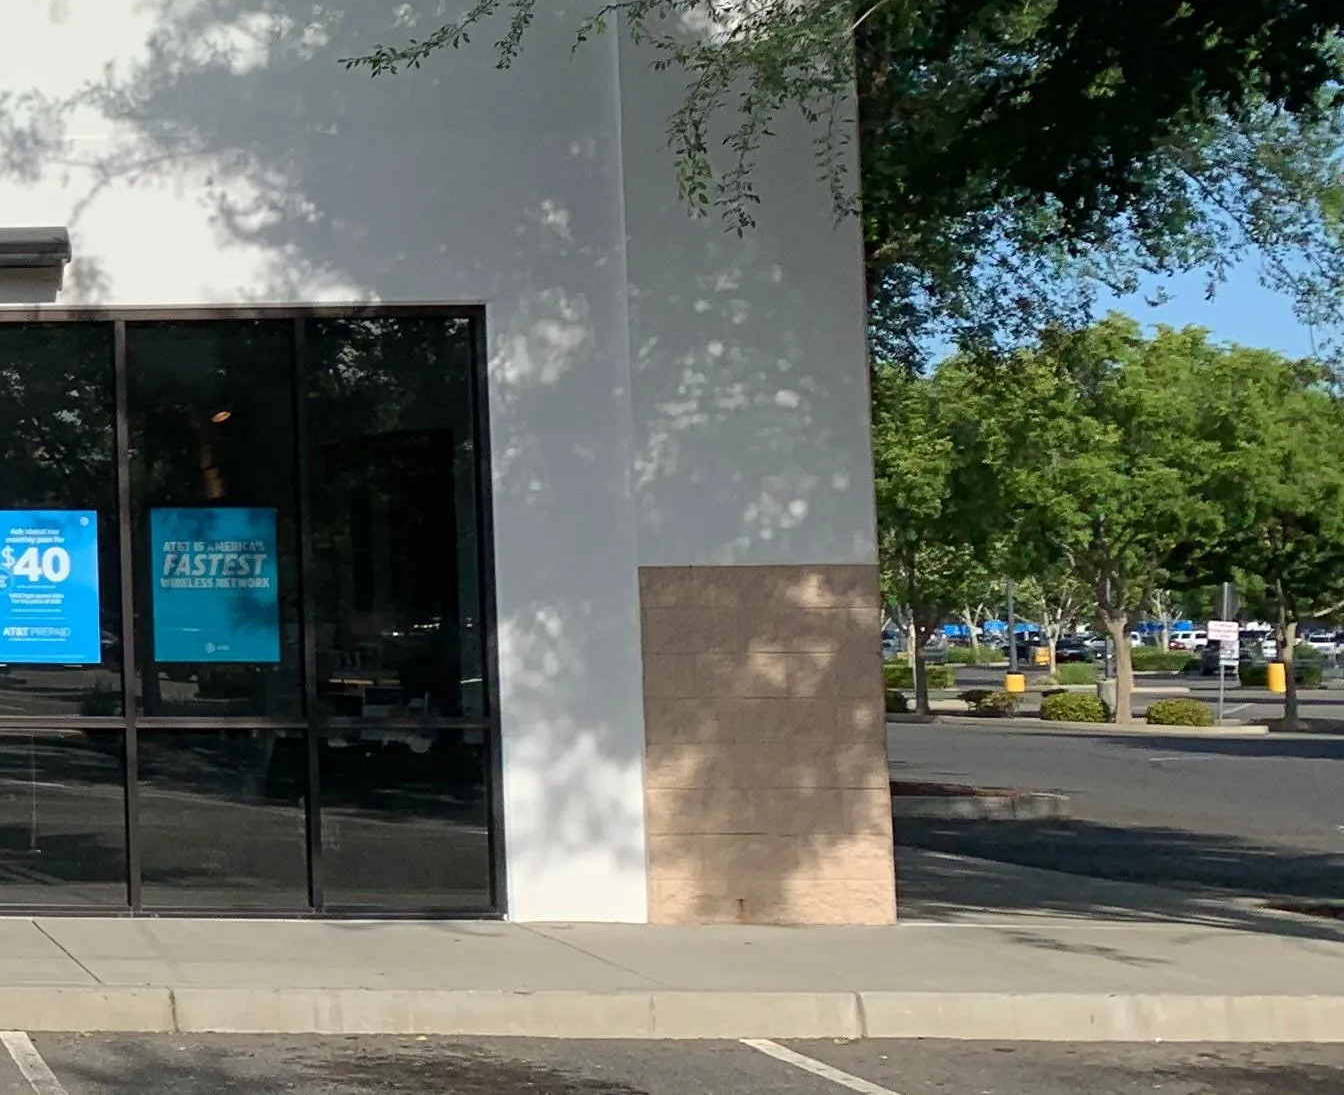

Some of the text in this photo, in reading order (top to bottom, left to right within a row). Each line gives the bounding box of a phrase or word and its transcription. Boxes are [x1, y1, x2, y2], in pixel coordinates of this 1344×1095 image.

[163, 541, 191, 552] AT&T
[193, 541, 205, 552] IS
[1, 545, 71, 583] $40
[163, 553, 268, 576] FASTEST
[160, 577, 270, 588] WIRELESS NETWORK
[2, 627, 71, 637] AT&T PREPAID
